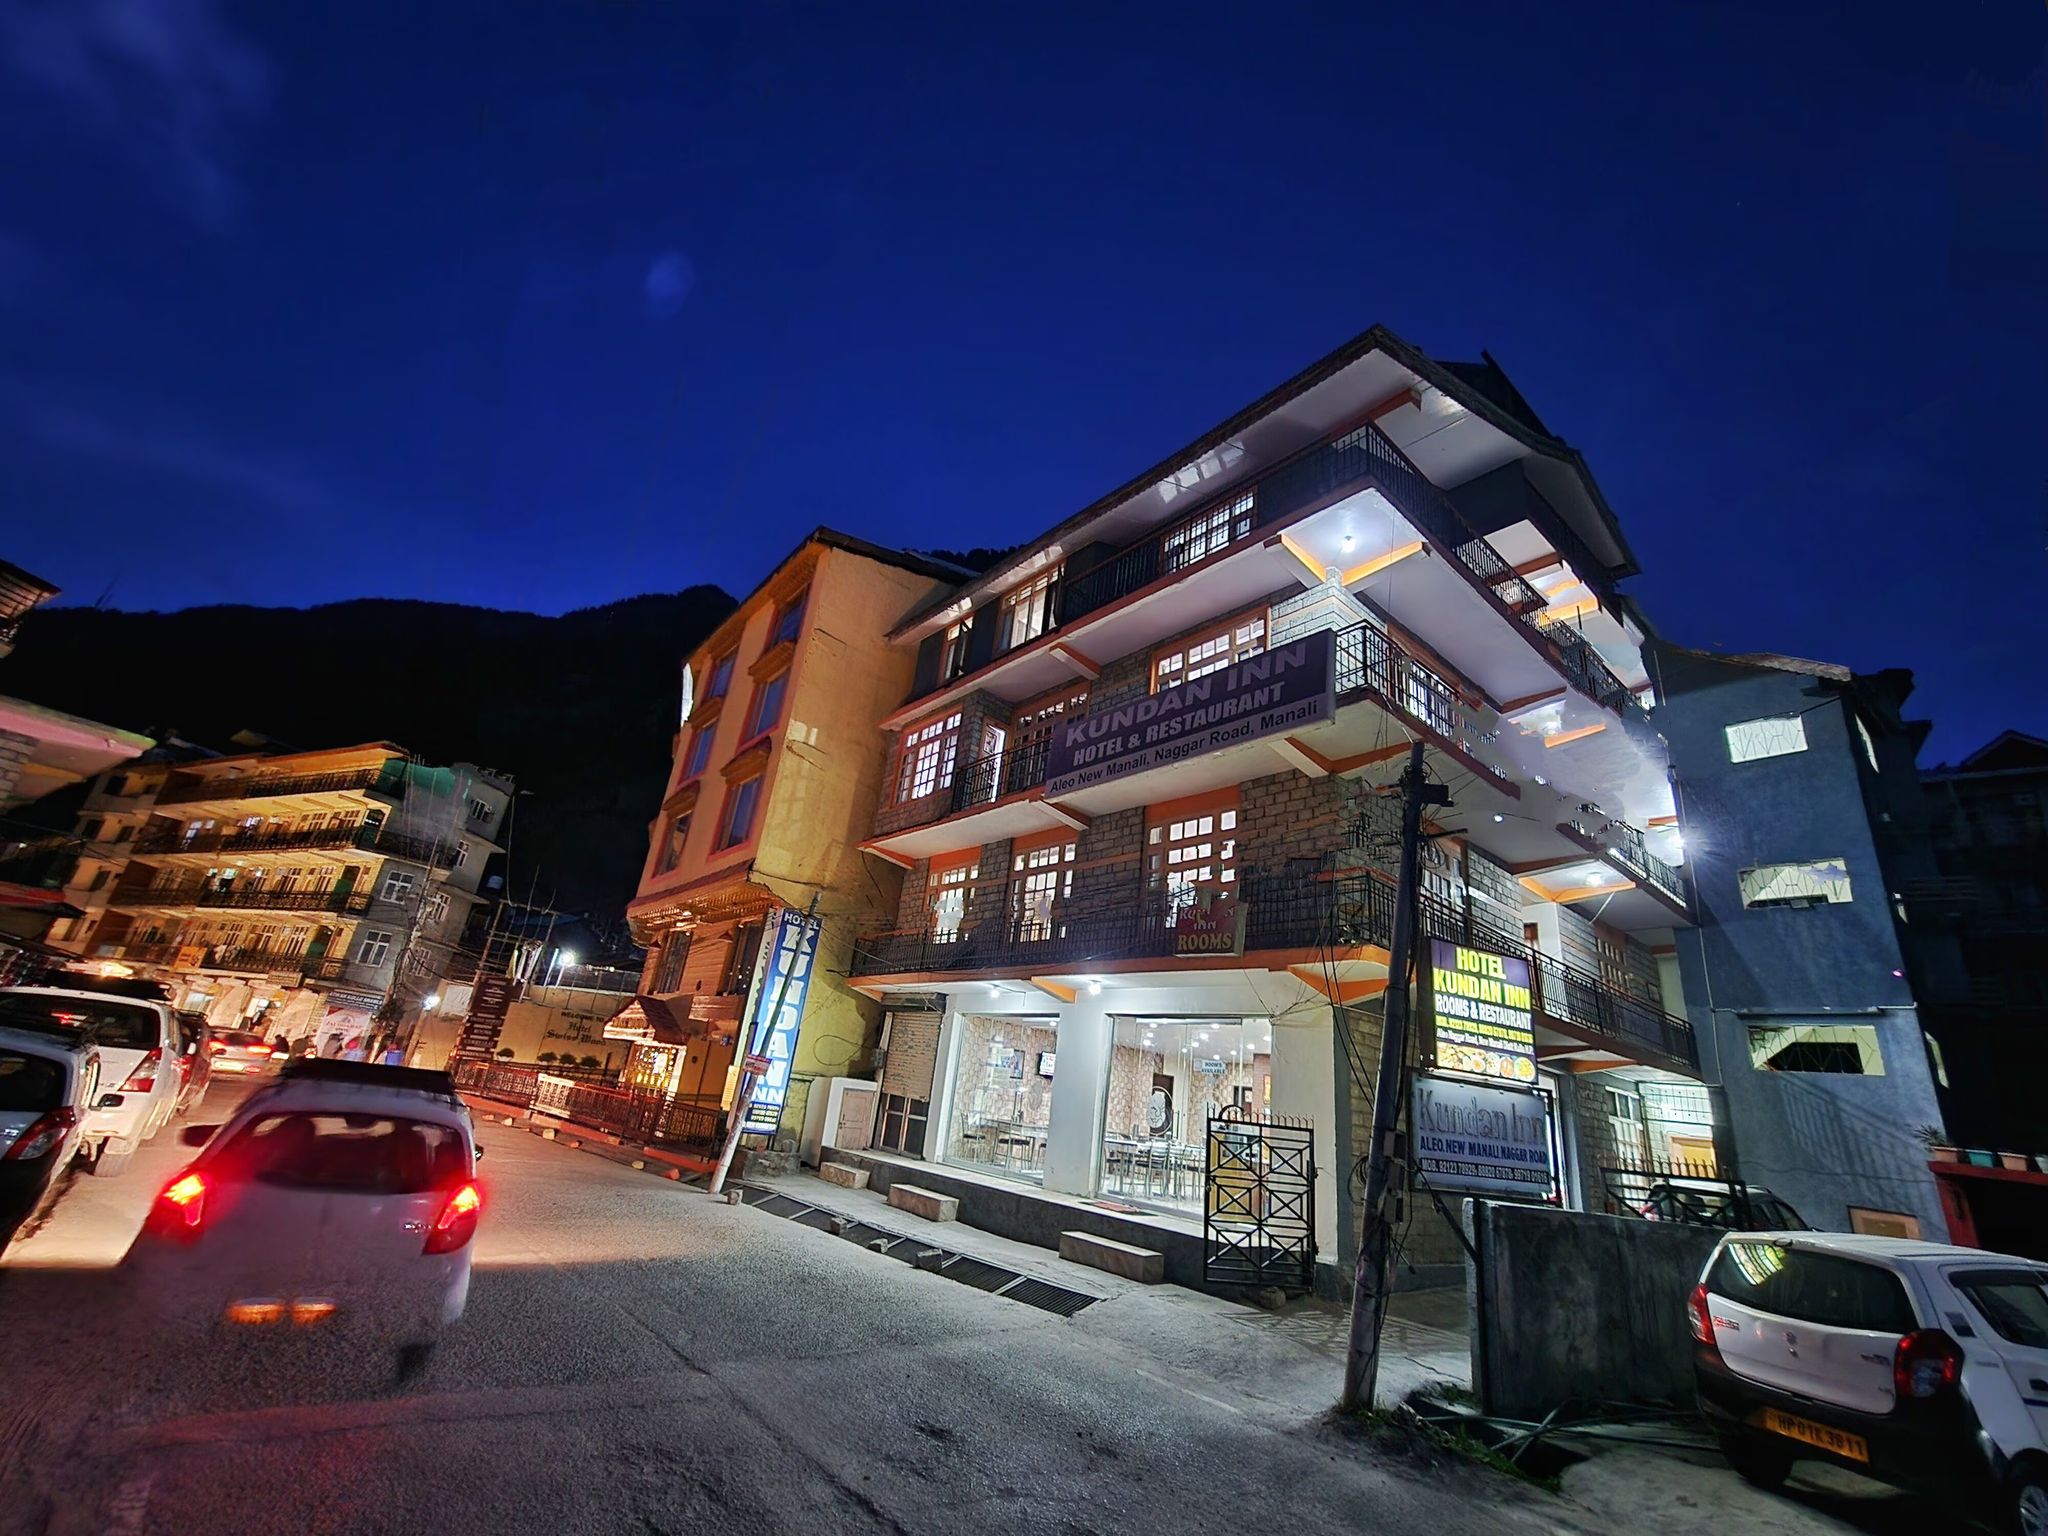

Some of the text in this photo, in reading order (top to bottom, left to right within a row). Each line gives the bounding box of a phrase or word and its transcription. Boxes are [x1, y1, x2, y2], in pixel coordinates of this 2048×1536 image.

[1065, 642, 1306, 747] KUNDAN INN
[1073, 681, 1286, 767] HOTEL & RESTAURANT
[1051, 701, 1318, 793] Aleo New Manali, Naggar Road, Manali
[1177, 932, 1233, 951] ROOMS
[1456, 947, 1507, 980] HOTEL
[1433, 967, 1531, 1010] KUNDAN INN
[1434, 993, 1469, 1018] ROOMS
[1470, 1000, 1479, 1020] &
[1479, 1002, 1532, 1031] RESTAURANT
[1418, 1087, 1547, 1146] Kundan Inn
[1446, 1139, 1465, 1156] NEW
